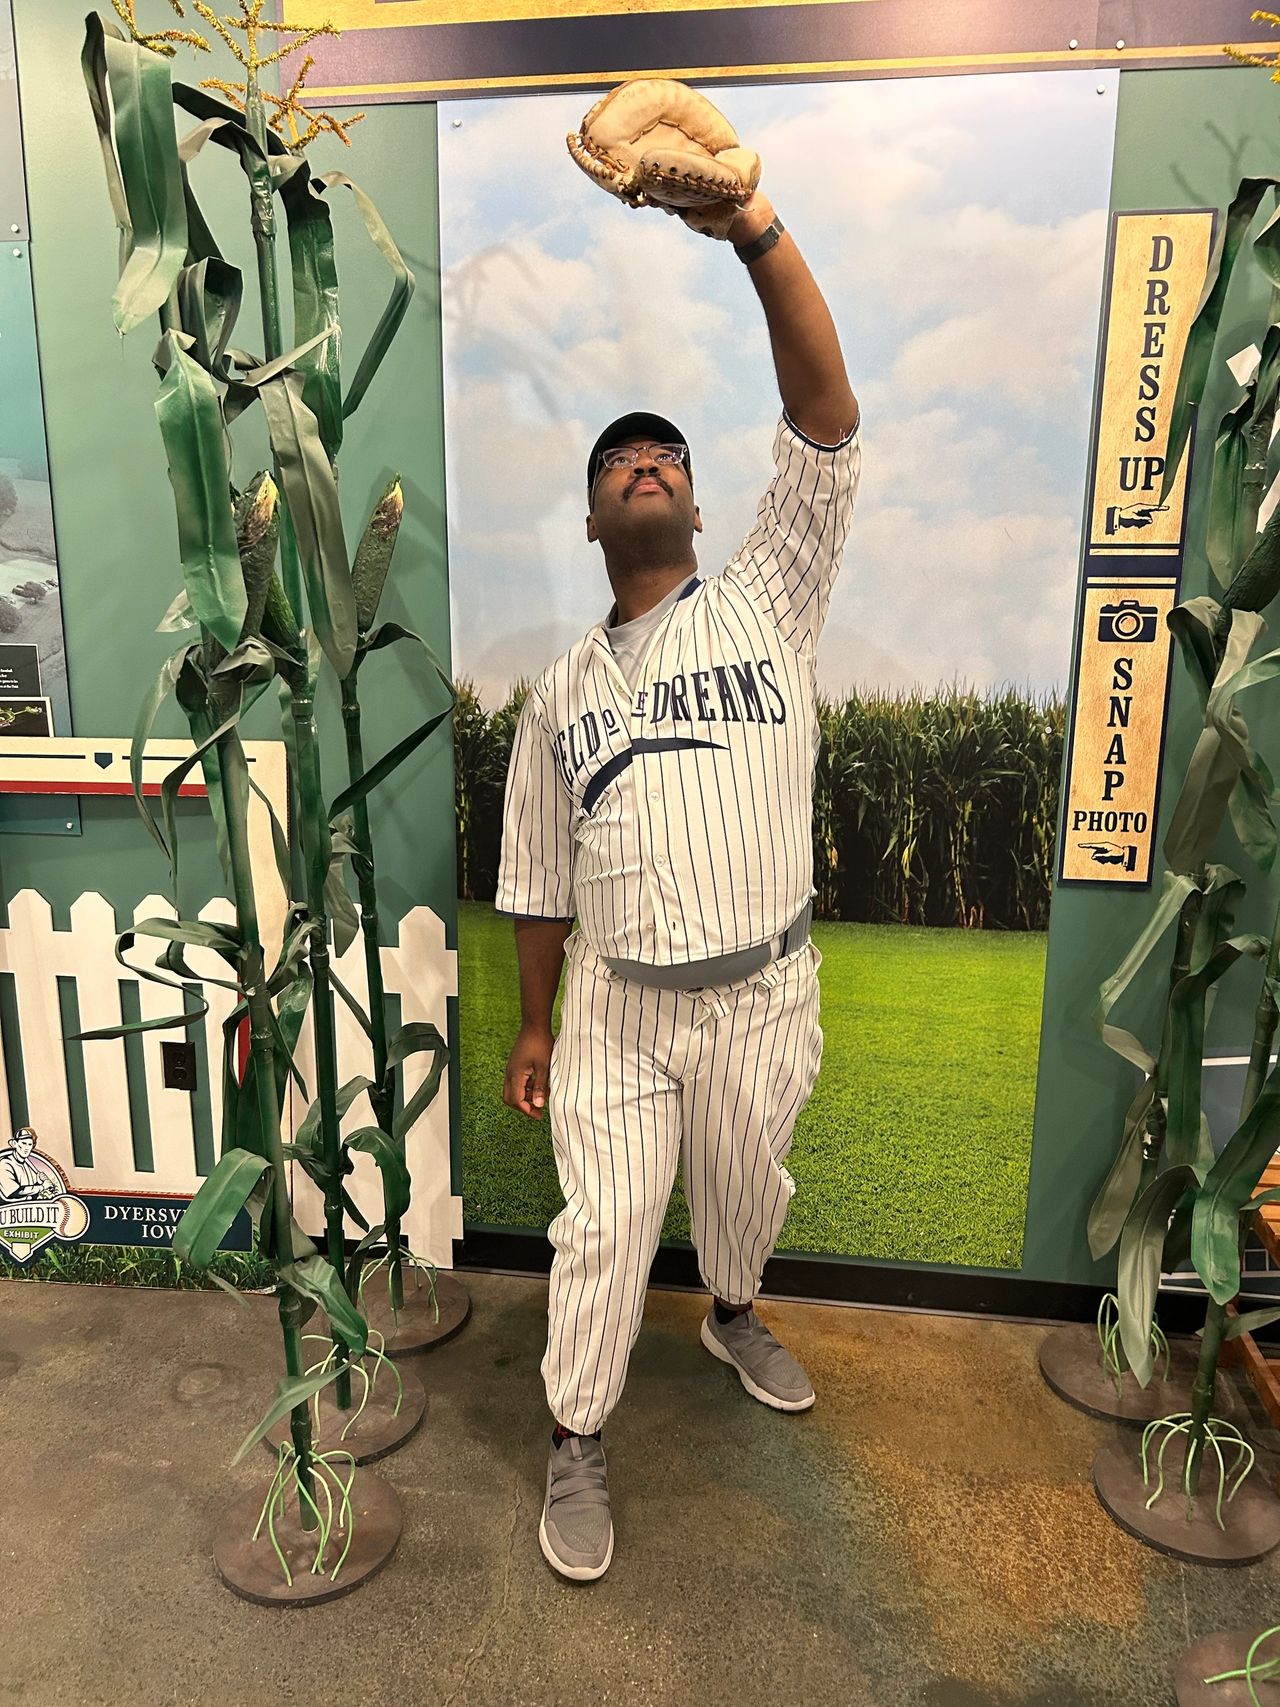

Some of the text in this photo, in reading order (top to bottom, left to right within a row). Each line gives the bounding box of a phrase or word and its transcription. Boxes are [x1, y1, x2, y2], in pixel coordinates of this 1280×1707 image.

[1118, 235, 1175, 491] DRESS UP
[650, 658, 787, 725] DREAMS
[1072, 657, 1148, 833] SNAP PHOTO
[3, 1229, 40, 1240] EXHIBIT
[9, 1206, 45, 1225] BUILD
[46, 1206, 60, 1224] IT
[104, 1205, 187, 1223] DYERSV
